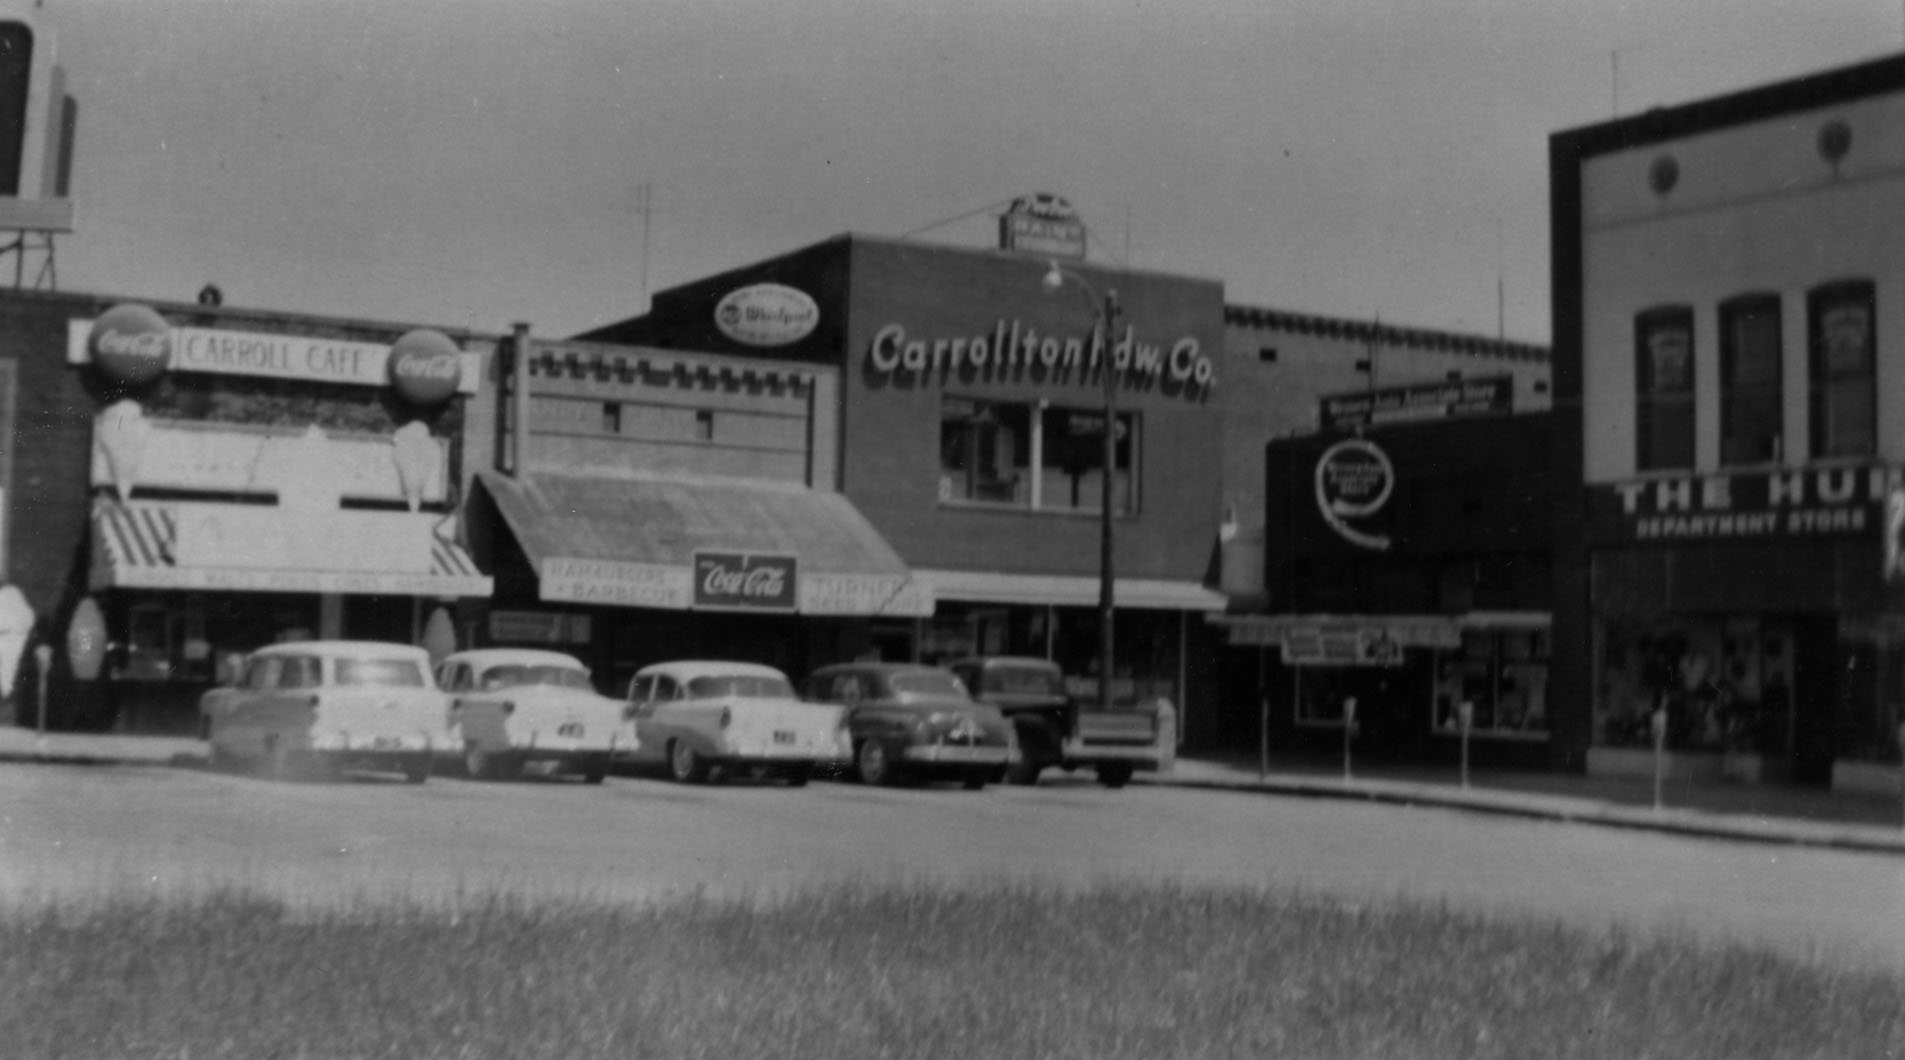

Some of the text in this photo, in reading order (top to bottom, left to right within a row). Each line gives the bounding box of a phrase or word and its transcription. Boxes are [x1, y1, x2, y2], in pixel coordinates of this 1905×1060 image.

[186, 336, 290, 370] CARROLL
[872, 319, 1082, 372] Carrollton
[1168, 336, 1217, 387] Co.
[1614, 478, 1731, 514] THE
[1636, 507, 1864, 539] DEPARTMENT STORE
[572, 581, 681, 607] BARBECUE
[703, 563, 787, 596] Coca-Cola
